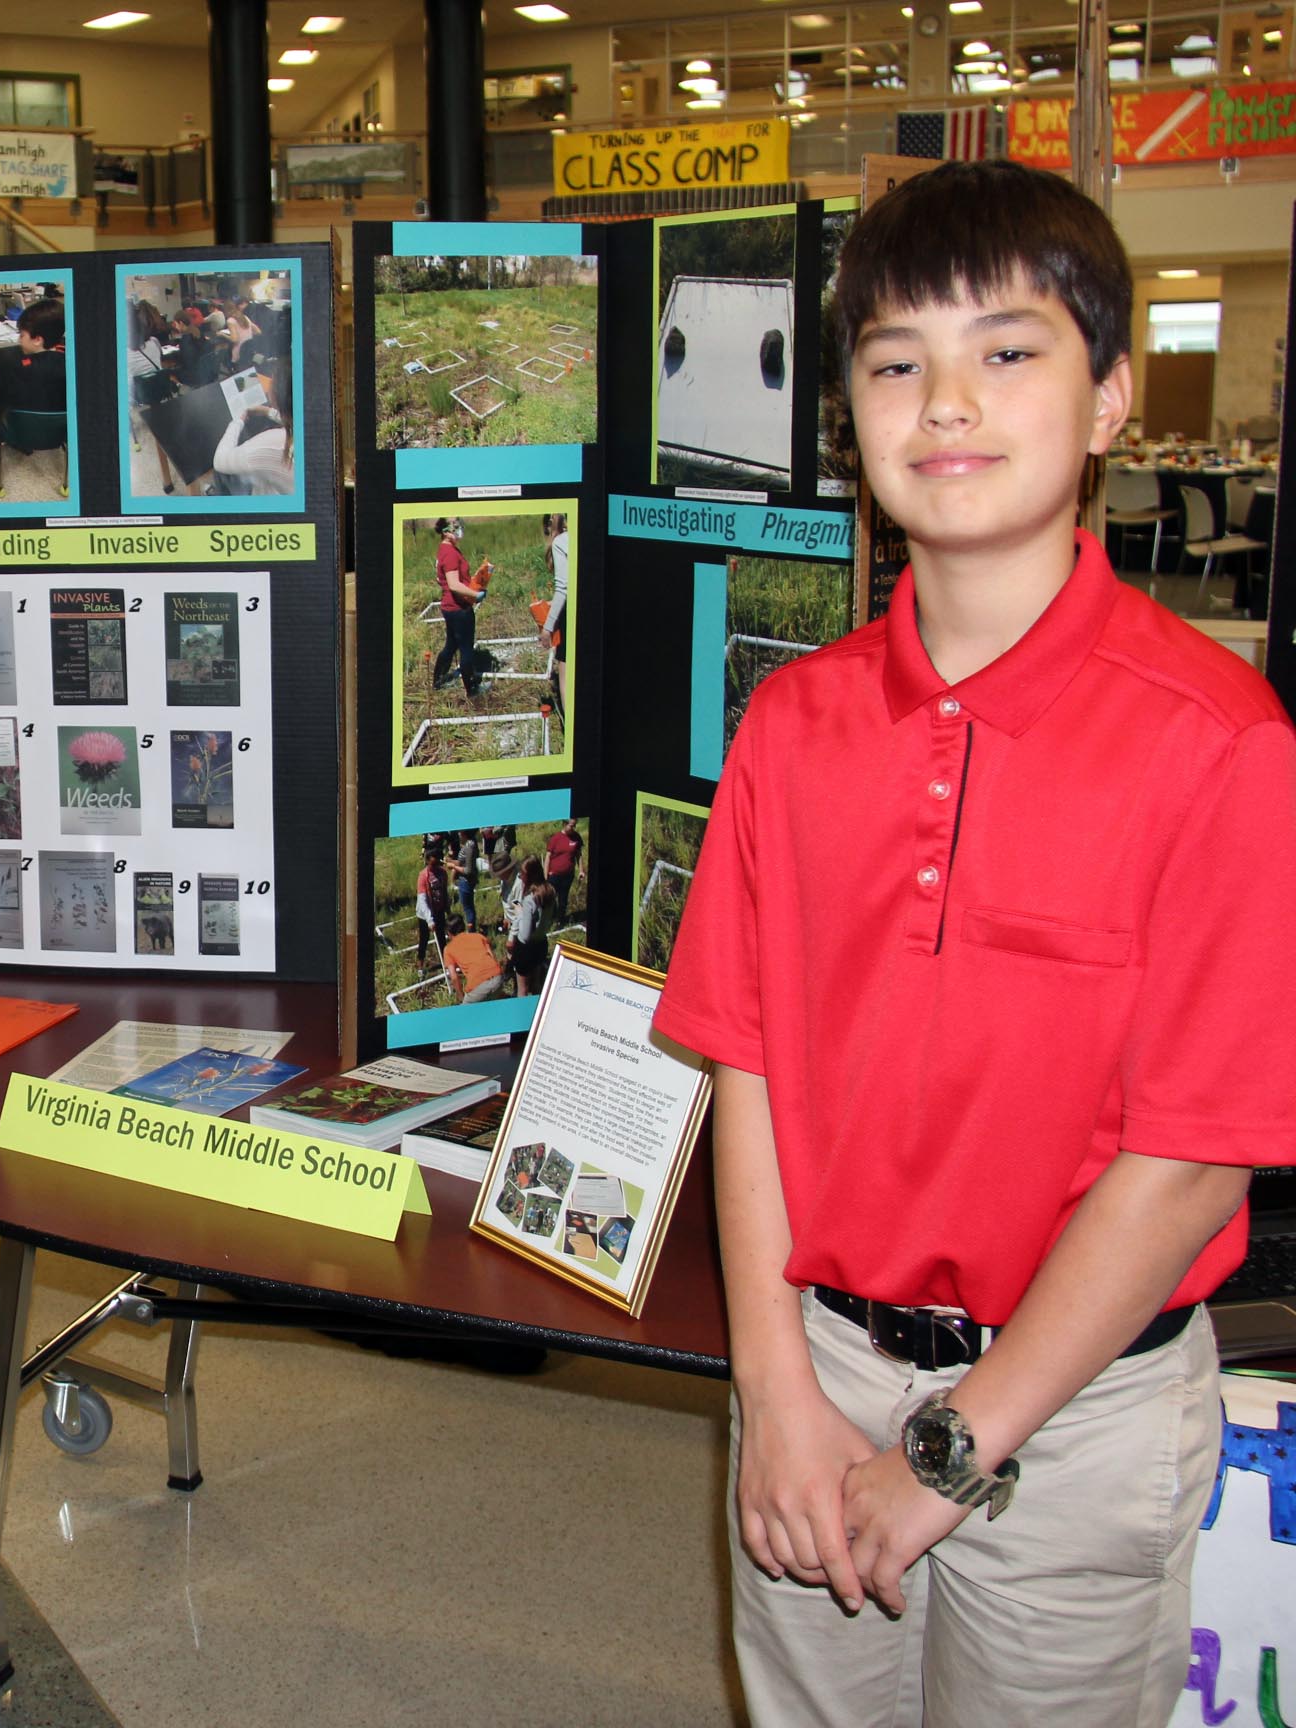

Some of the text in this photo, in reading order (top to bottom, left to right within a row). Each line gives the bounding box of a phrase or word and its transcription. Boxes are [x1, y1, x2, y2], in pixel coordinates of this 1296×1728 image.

[589, 133, 644, 149] TURNING
[655, 132, 672, 145] UP
[680, 128, 700, 142] THE
[746, 123, 770, 138] FOR
[562, 142, 759, 190] CLASS COMP
[623, 500, 737, 541] Investigating
[760, 511, 855, 550] Phragmit
[89, 529, 179, 556] Invasive
[209, 528, 301, 554] Species
[53, 592, 111, 604] INVASIVE
[128, 597, 142, 613] 2
[172, 597, 209, 610] Weeds
[245, 596, 260, 612] 3
[17, 599, 27, 613] 1
[83, 602, 121, 613] Plants
[174, 609, 231, 622] Northeast
[22, 723, 35, 738] 4
[140, 734, 154, 749] 5
[237, 737, 252, 752] 6
[67, 787, 132, 809] Weeds
[21, 857, 33, 871] 7
[113, 859, 127, 874] 8
[178, 880, 191, 894] 9
[244, 880, 270, 895] 10
[603, 991, 624, 1004] VIRGINIA
[626, 1000, 643, 1010] BEACH
[577, 1020, 662, 1059] Virginia Beach Middle School
[590, 1039, 639, 1064] Invasive Species
[27, 1085, 397, 1192] Virginia Beach Middle School
